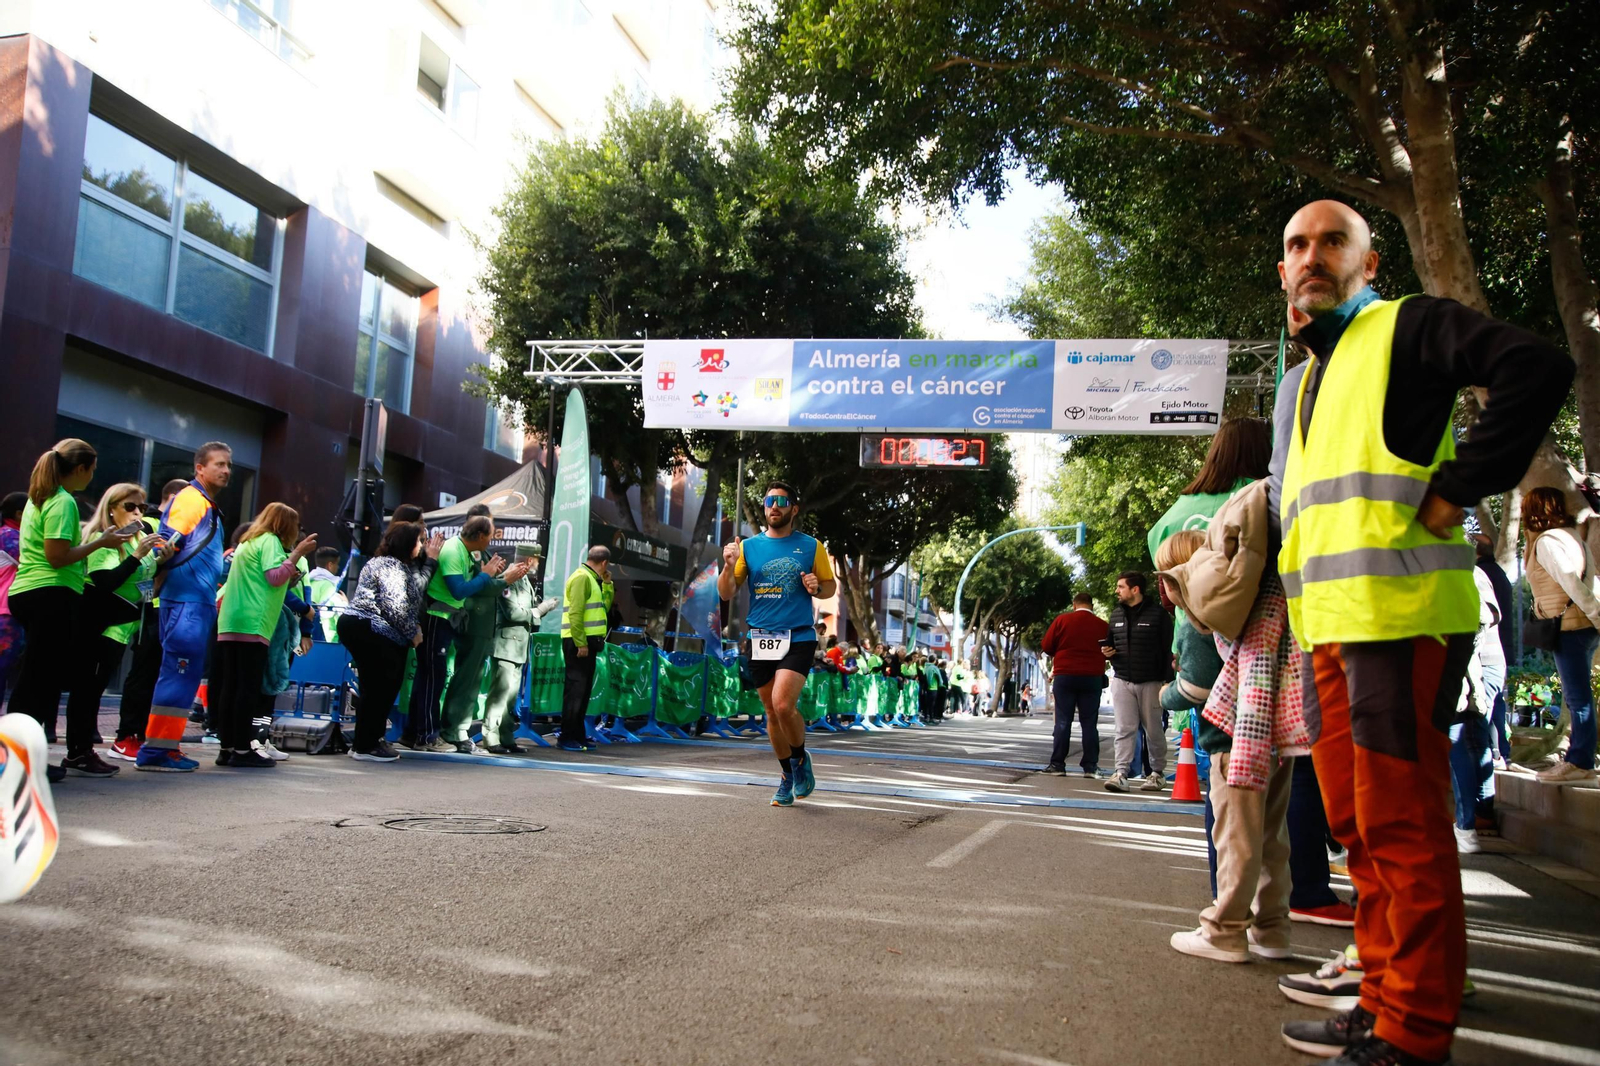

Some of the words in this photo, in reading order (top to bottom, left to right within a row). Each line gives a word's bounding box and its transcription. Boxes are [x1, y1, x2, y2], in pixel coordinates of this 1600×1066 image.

[808, 349, 901, 369] Almería
[908, 353, 937, 368] en
[945, 349, 1038, 369] marcha
[1085, 352, 1136, 365] cajamar
[807, 376, 884, 395] contra
[891, 375, 914, 395] el
[920, 375, 1006, 395] cáncer
[1132, 381, 1190, 393] Fundación
[1161, 401, 1181, 410] Ejido
[799, 412, 877, 420] #TodosContraElCáncer
[759, 639, 782, 650] 687
